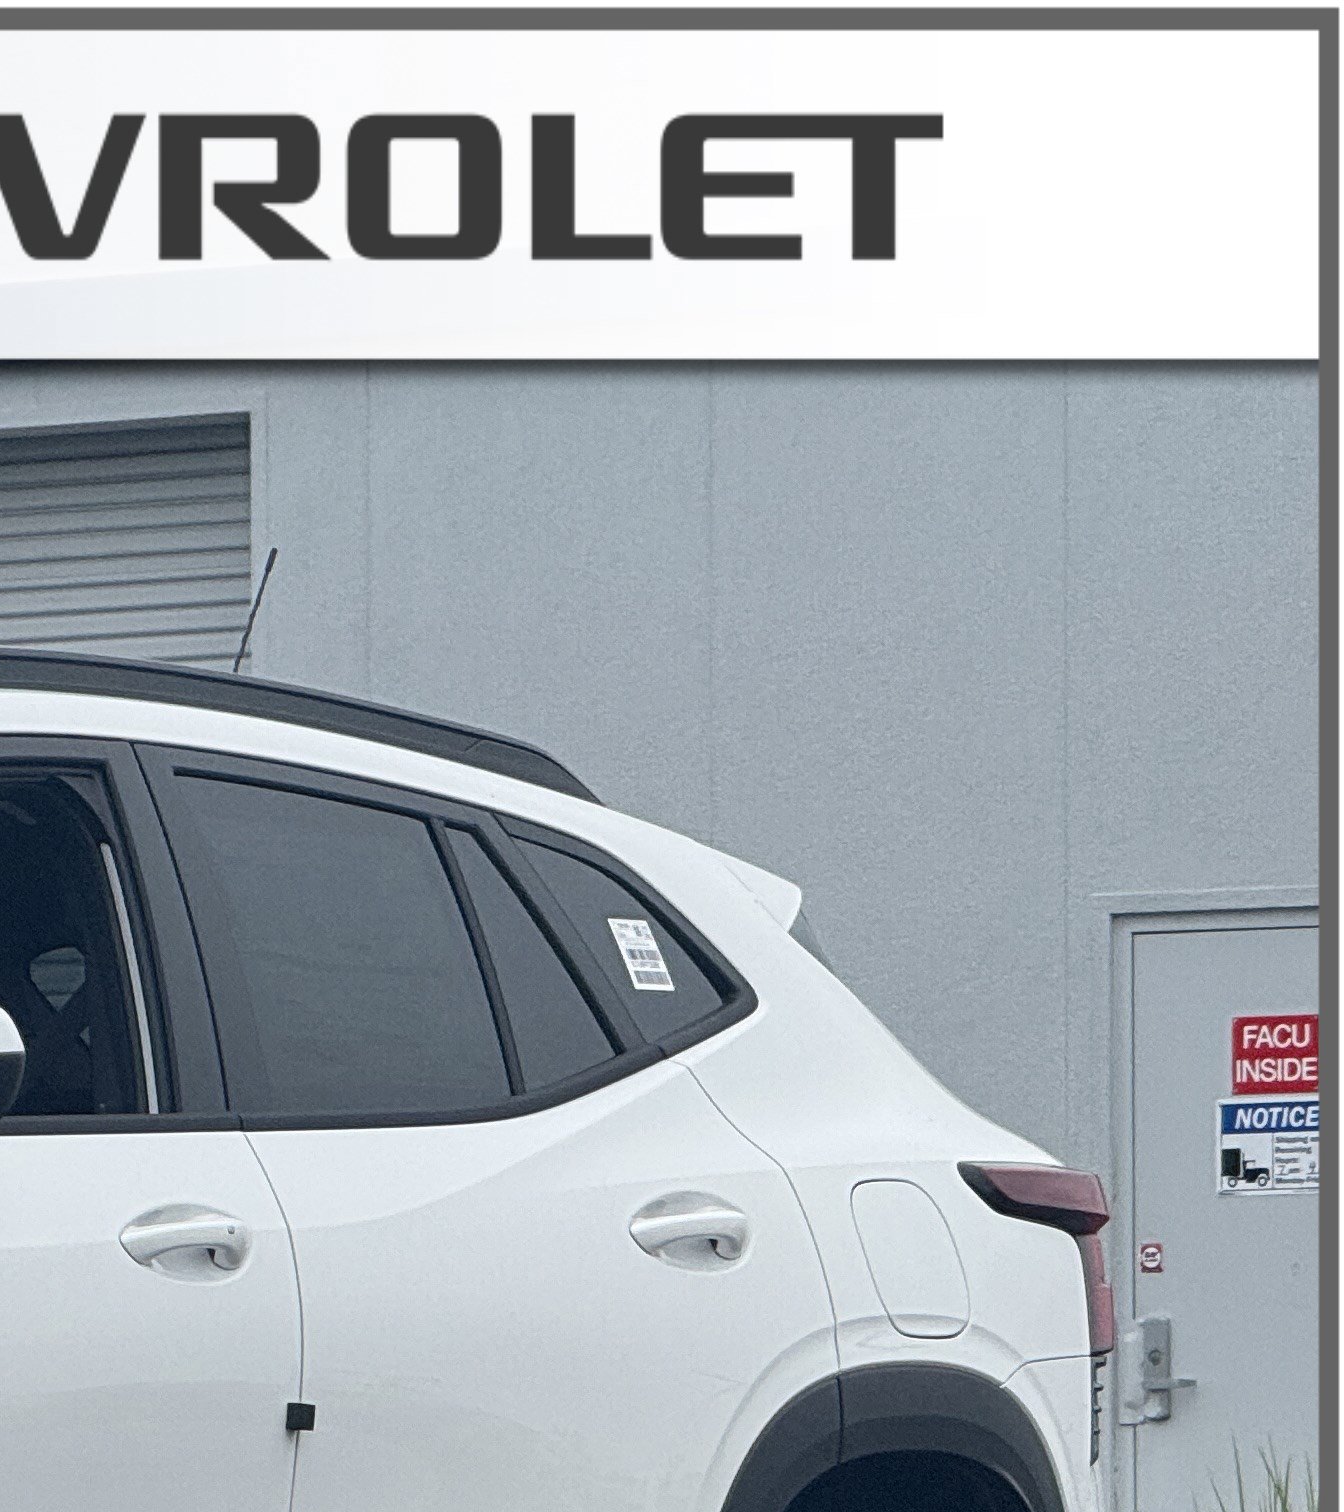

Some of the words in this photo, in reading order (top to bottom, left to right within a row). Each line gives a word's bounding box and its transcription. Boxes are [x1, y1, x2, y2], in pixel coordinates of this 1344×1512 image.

[1242, 1023, 1311, 1050] FACU
[1235, 1057, 1318, 1082] INSIDE
[1234, 1105, 1319, 1130] NOTICE
